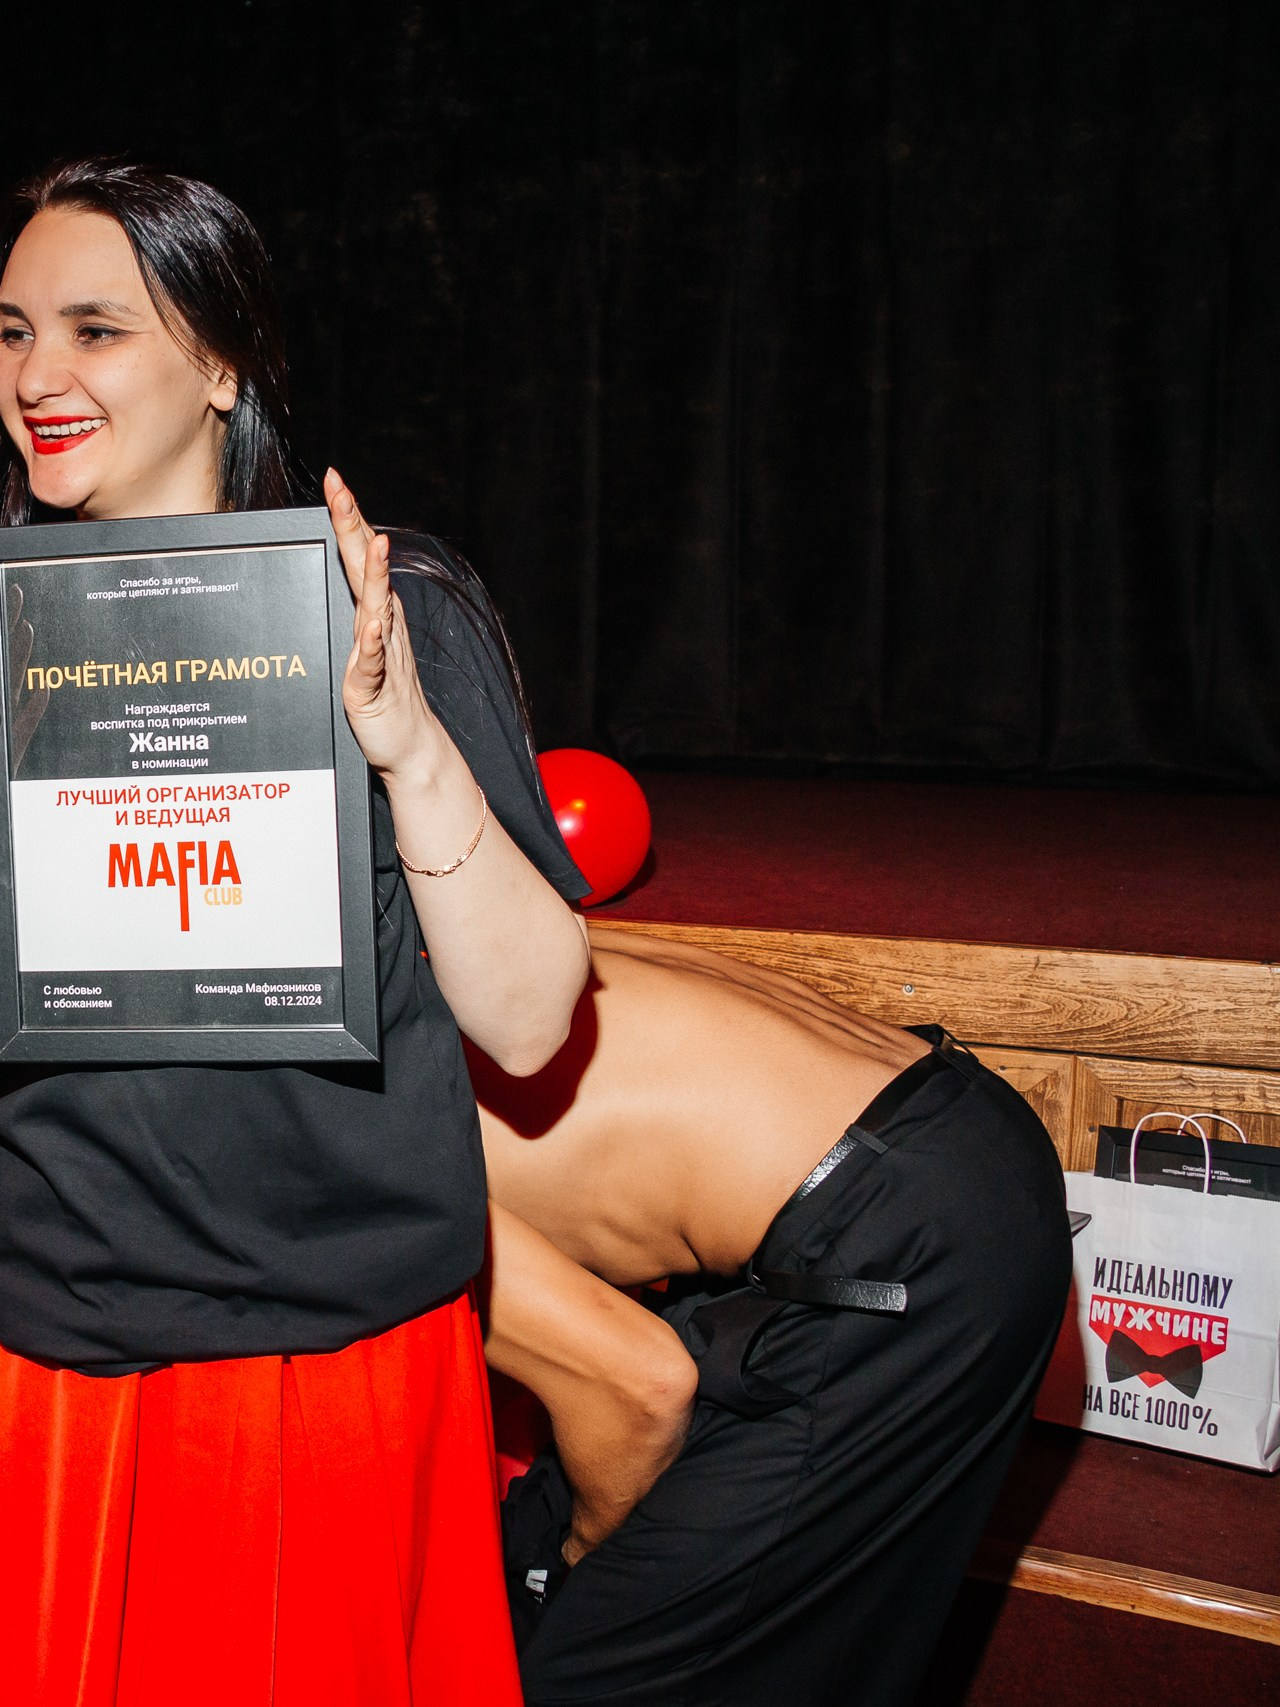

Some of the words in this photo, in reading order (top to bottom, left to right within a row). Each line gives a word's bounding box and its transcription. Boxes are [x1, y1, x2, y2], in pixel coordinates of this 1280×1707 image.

[86, 590, 127, 600] которые
[128, 588, 170, 599] цепляют
[171, 587, 179, 595] и
[180, 582, 239, 595] затягивают!
[120, 577, 160, 588] Спасибо
[162, 577, 173, 586] за
[175, 576, 202, 587] игры,
[26, 660, 168, 690] ПОЧЁТНАЯ
[174, 654, 307, 683] ГРАМОТА
[125, 702, 210, 717] Награждается
[90, 718, 145, 731] воспитка
[147, 718, 169, 730] под
[172, 714, 247, 729] прикрытием
[128, 732, 210, 753] Жанна
[131, 760, 139, 769] в
[141, 756, 209, 770] номинации
[56, 784, 141, 806] ЛУЧШИЙ
[147, 782, 291, 803] ОРГАНИЗАТОР
[115, 810, 129, 826] И
[134, 807, 231, 828] ВЕДУЩАЯ
[107, 840, 242, 932] MAFIA
[204, 887, 243, 906] CLUB
[43, 985, 51, 996] С
[53, 985, 102, 996] любовью
[195, 983, 243, 995] Команда
[246, 982, 322, 995] Мафиозников
[44, 1000, 51, 1009] и
[53, 997, 113, 1009] обожанием
[264, 995, 323, 1007] 08.12.2024
[1093, 1256, 1233, 1309] ИДЕАЛЬНОМУ
[1091, 1300, 1226, 1345] МУЖЧИНЕ
[1083, 1383, 1103, 1413] НА
[1109, 1388, 1140, 1421] ВСЕ
[1144, 1396, 1218, 1437] 1000%
